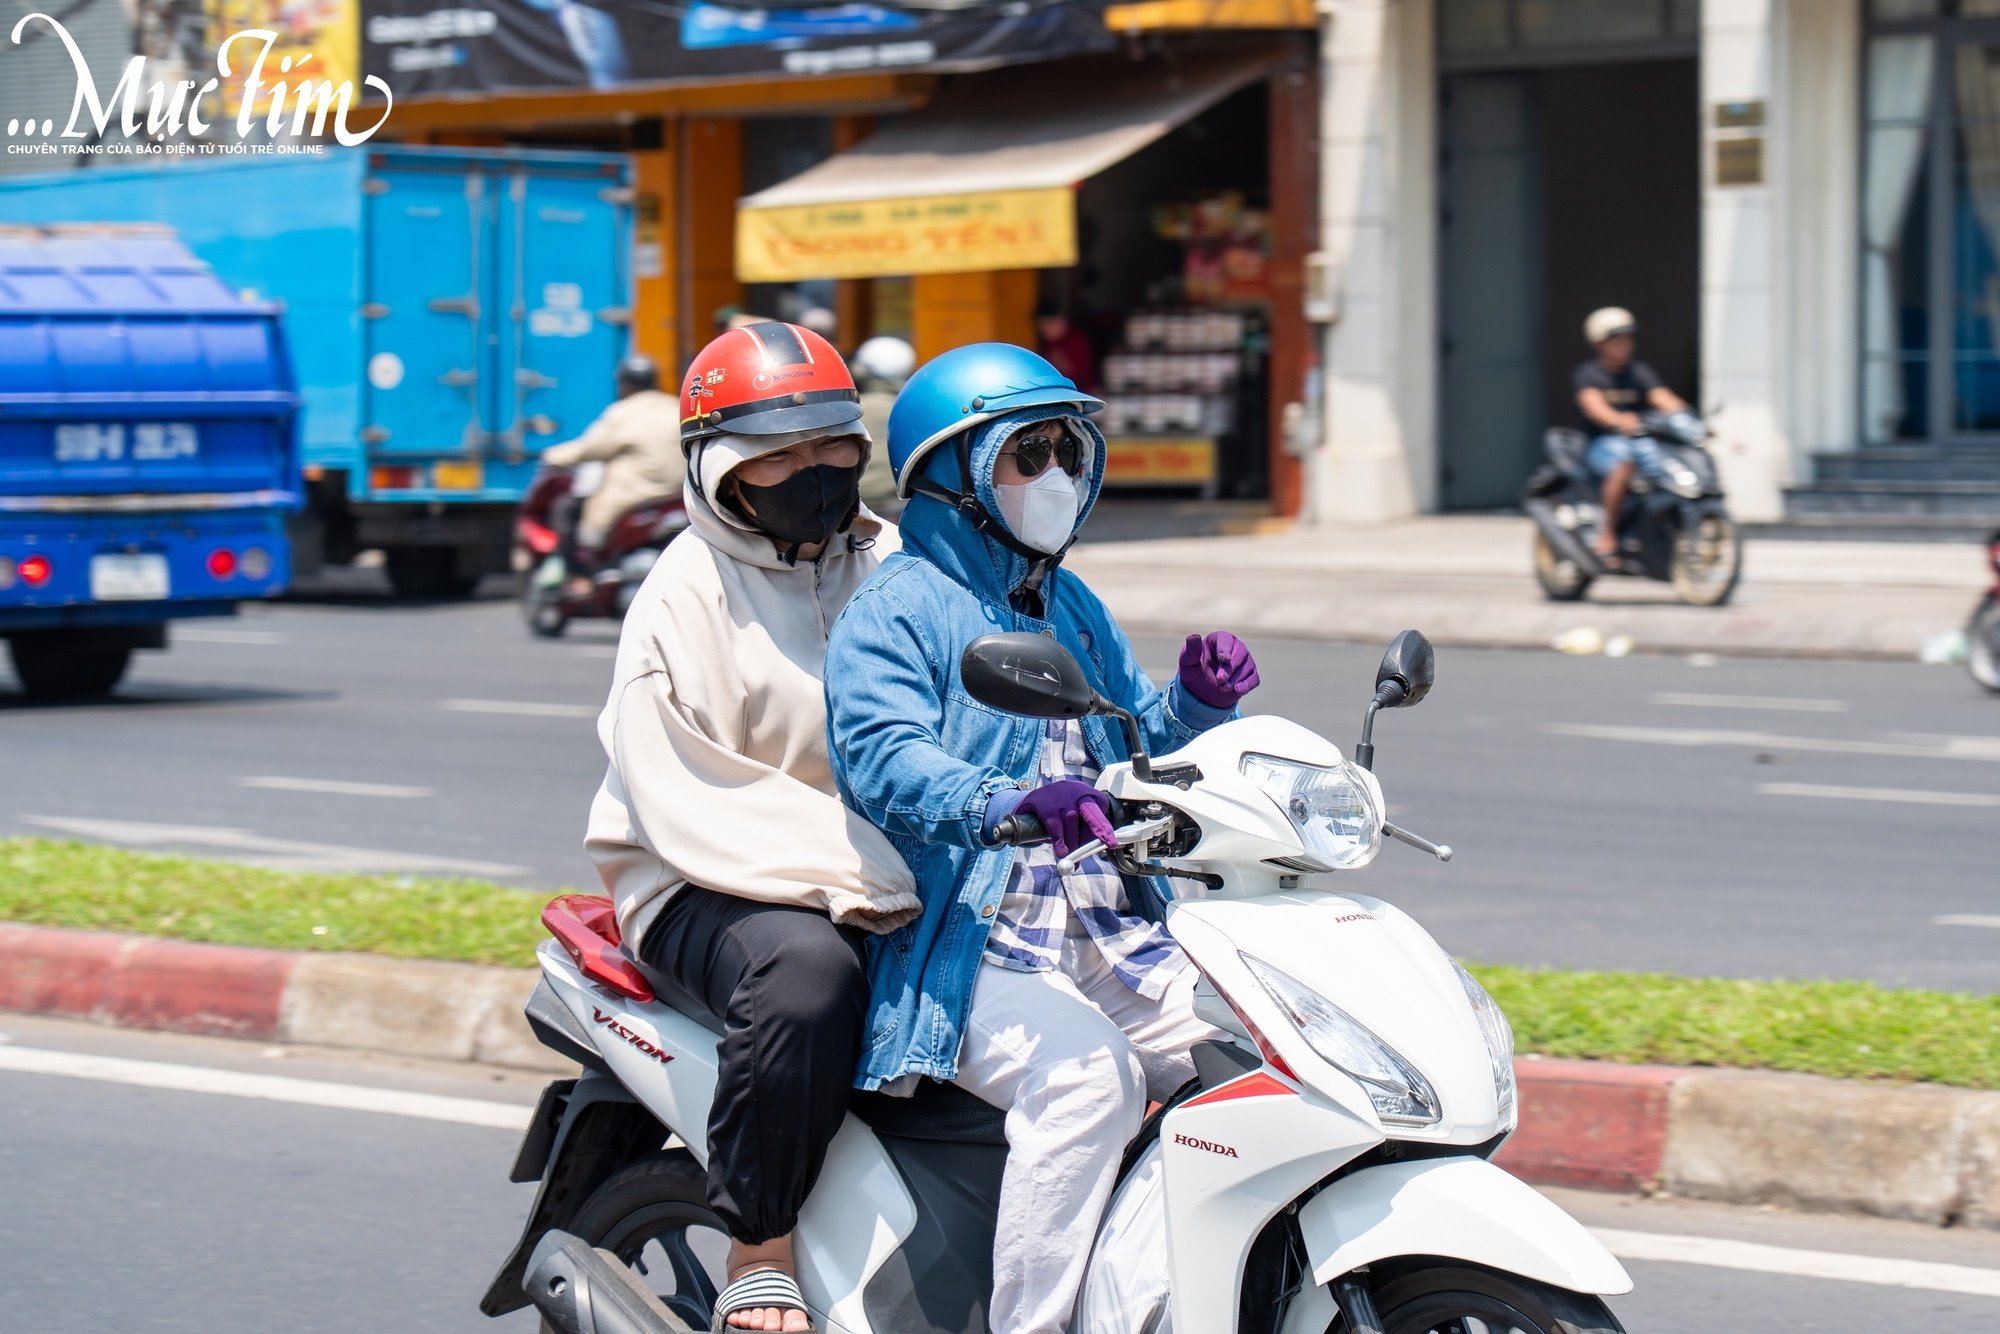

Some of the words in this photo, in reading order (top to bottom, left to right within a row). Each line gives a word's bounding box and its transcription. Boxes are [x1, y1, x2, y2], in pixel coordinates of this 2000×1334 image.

[773, 370, 814, 381] NONGSHIM
[592, 1005, 675, 1064] VISION
[1174, 1133, 1239, 1159] HONDA
